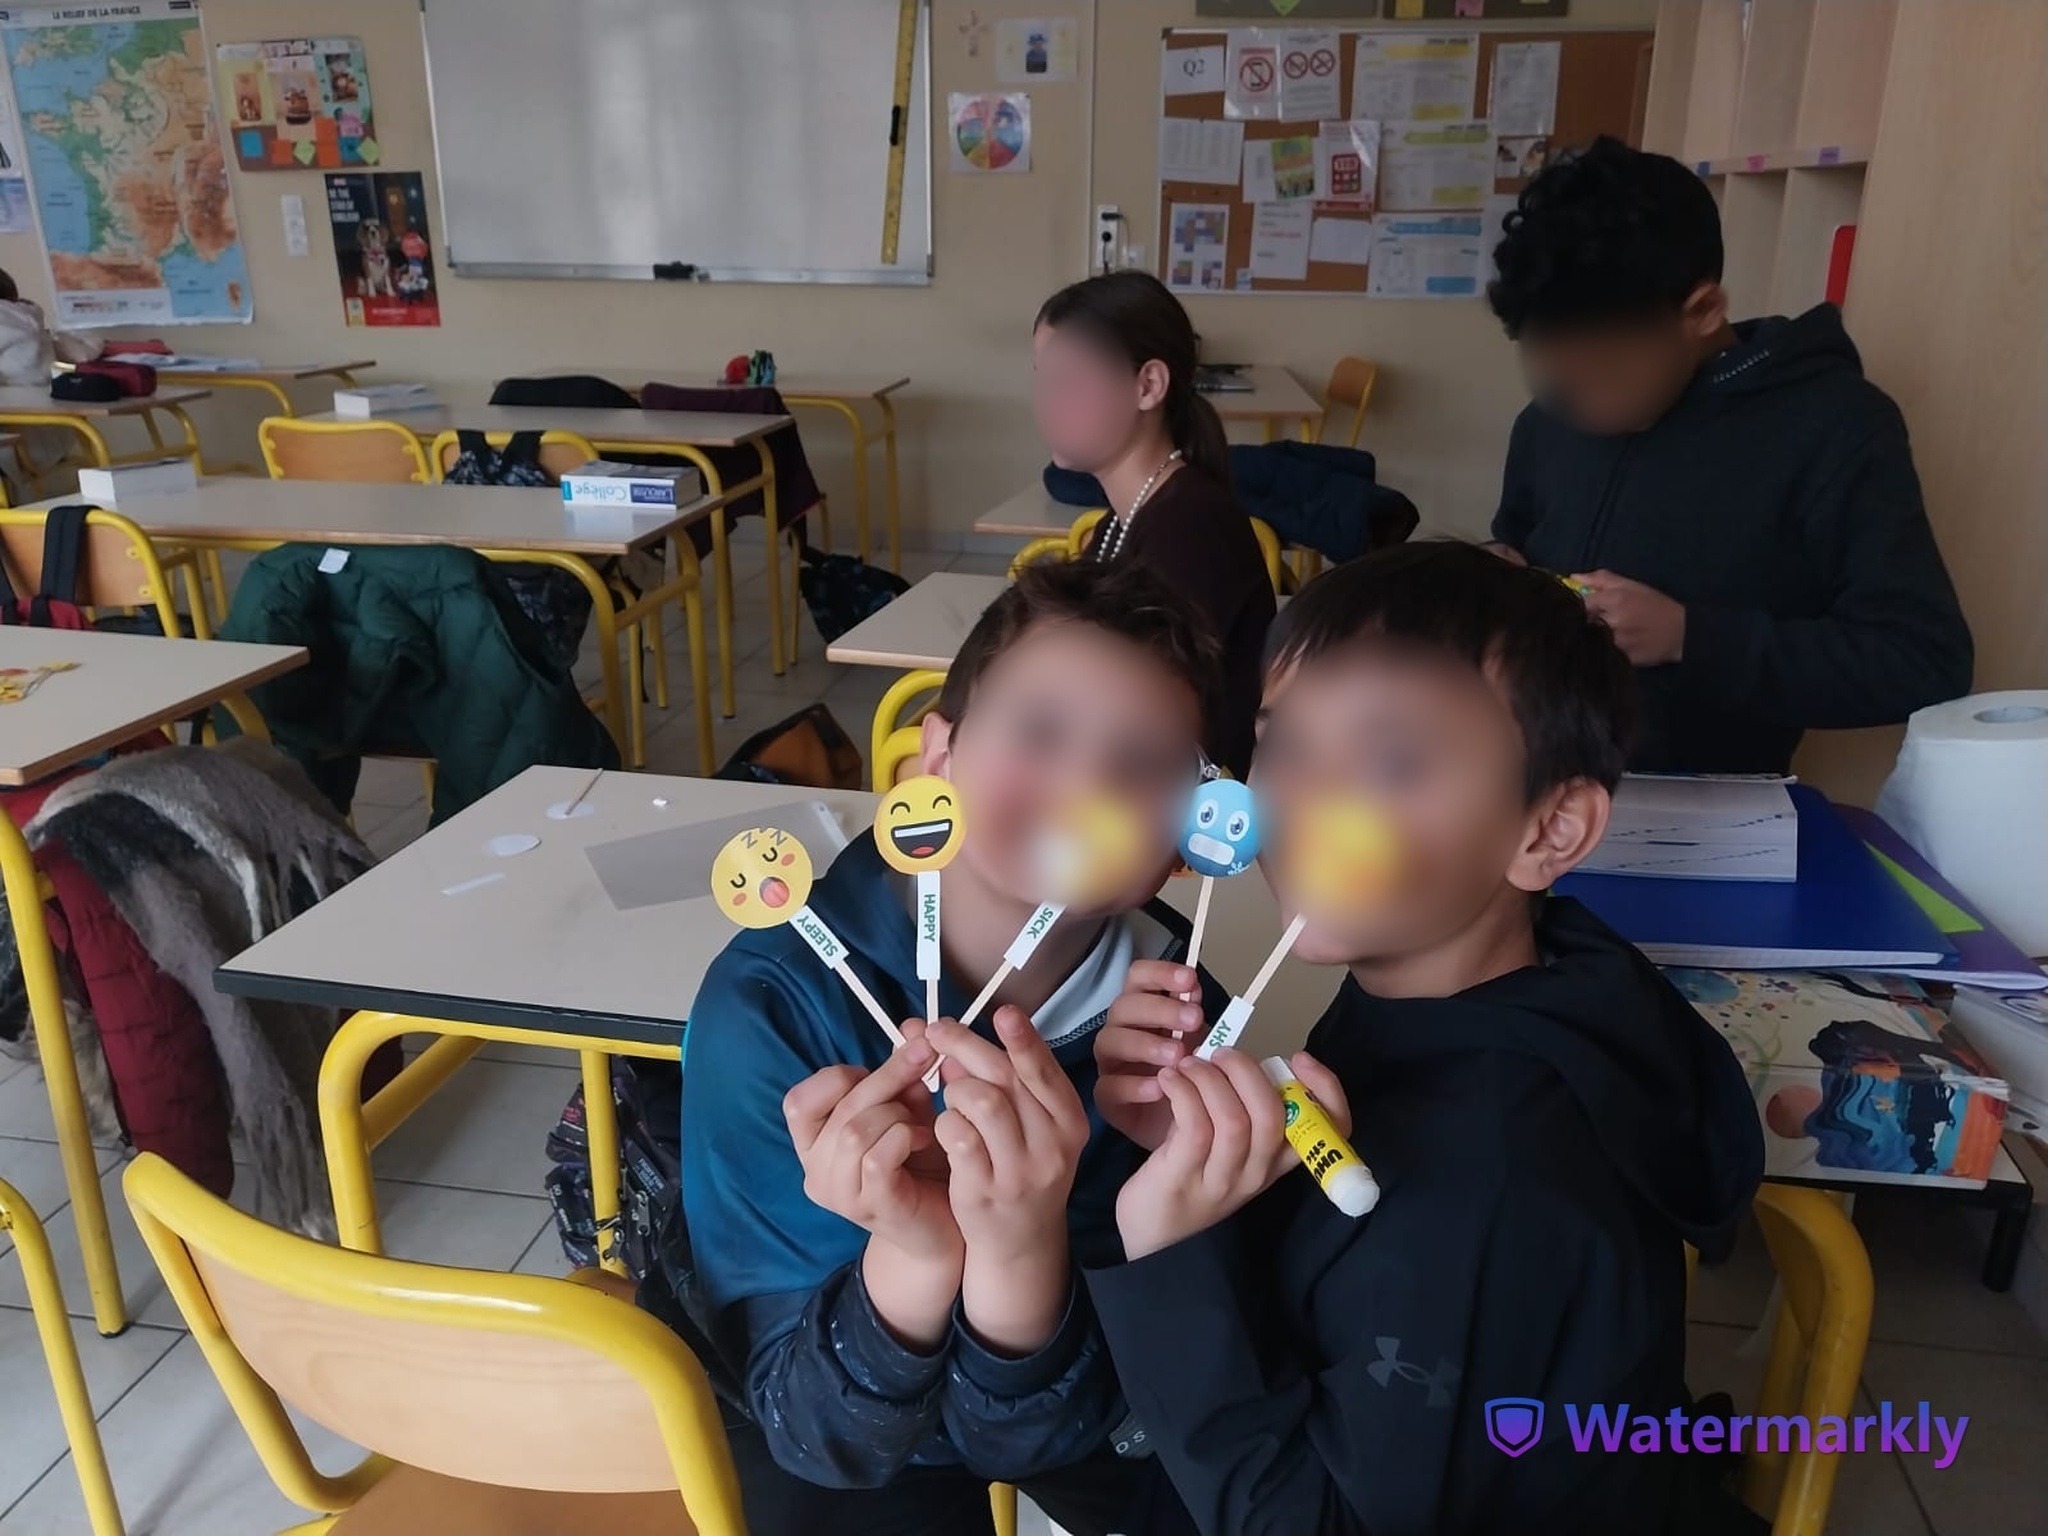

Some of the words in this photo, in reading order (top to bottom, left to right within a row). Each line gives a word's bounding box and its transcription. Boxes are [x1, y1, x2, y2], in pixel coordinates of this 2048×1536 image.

[88, 8, 97, 17] DE
[100, 7, 109, 16] LA
[111, 6, 141, 15] FRANCE
[1183, 59, 1205, 77] Q2
[924, 894, 936, 943] HAPPY
[1026, 907, 1054, 940] SICK
[797, 915, 838, 957] SLEEPY
[1209, 1020, 1231, 1047] SHY
[1314, 1149, 1343, 1185] UHU
